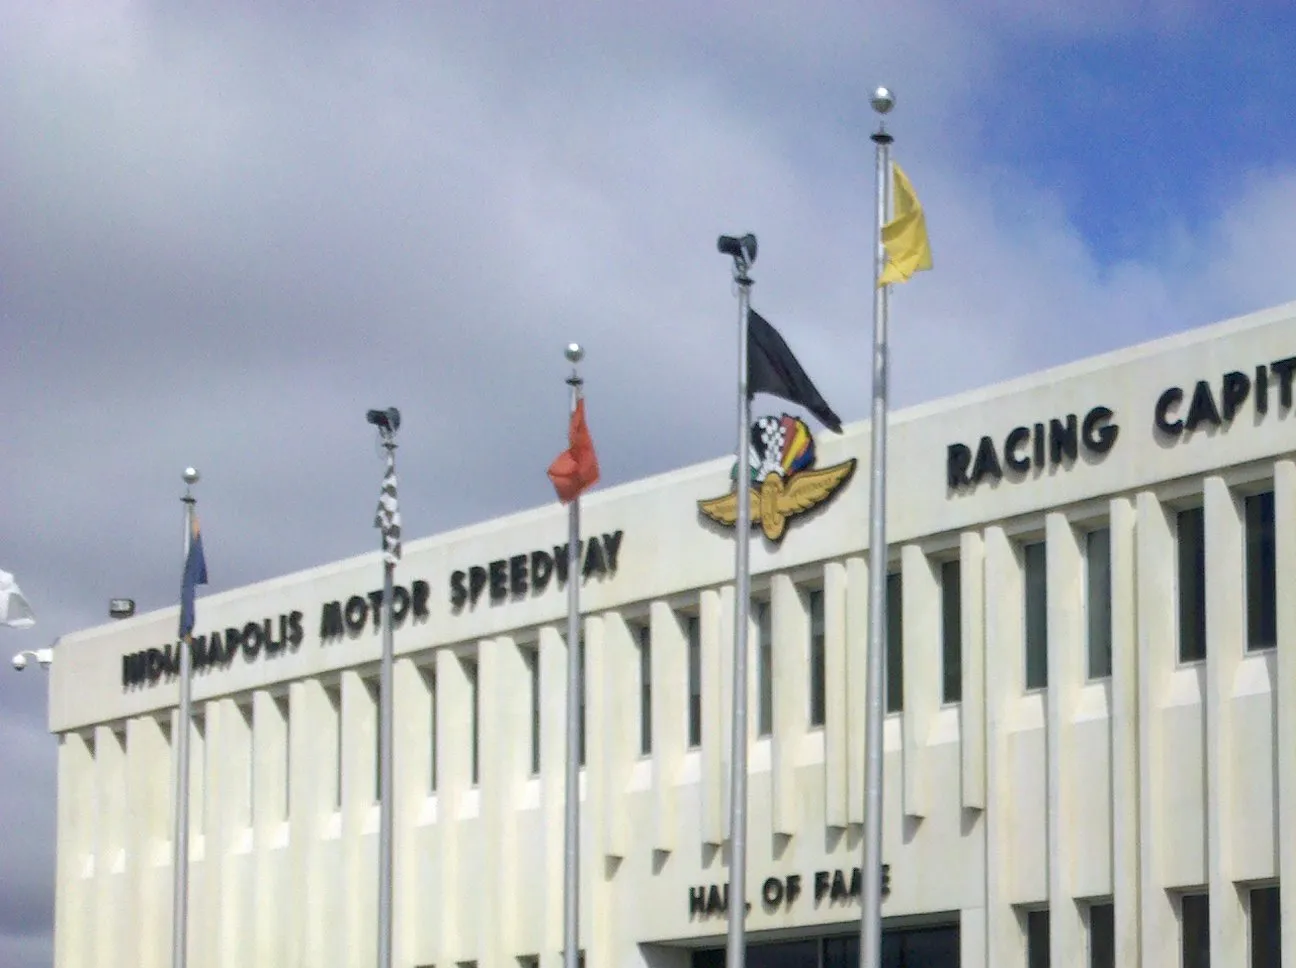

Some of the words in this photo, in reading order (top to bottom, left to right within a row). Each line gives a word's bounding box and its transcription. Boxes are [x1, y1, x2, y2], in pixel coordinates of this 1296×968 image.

[946, 406, 1119, 490] RACING
[320, 580, 430, 637] MOTOR
[450, 530, 624, 609] SPEEDWAY
[689, 883, 751, 914] HAL
[762, 875, 802, 905] OF
